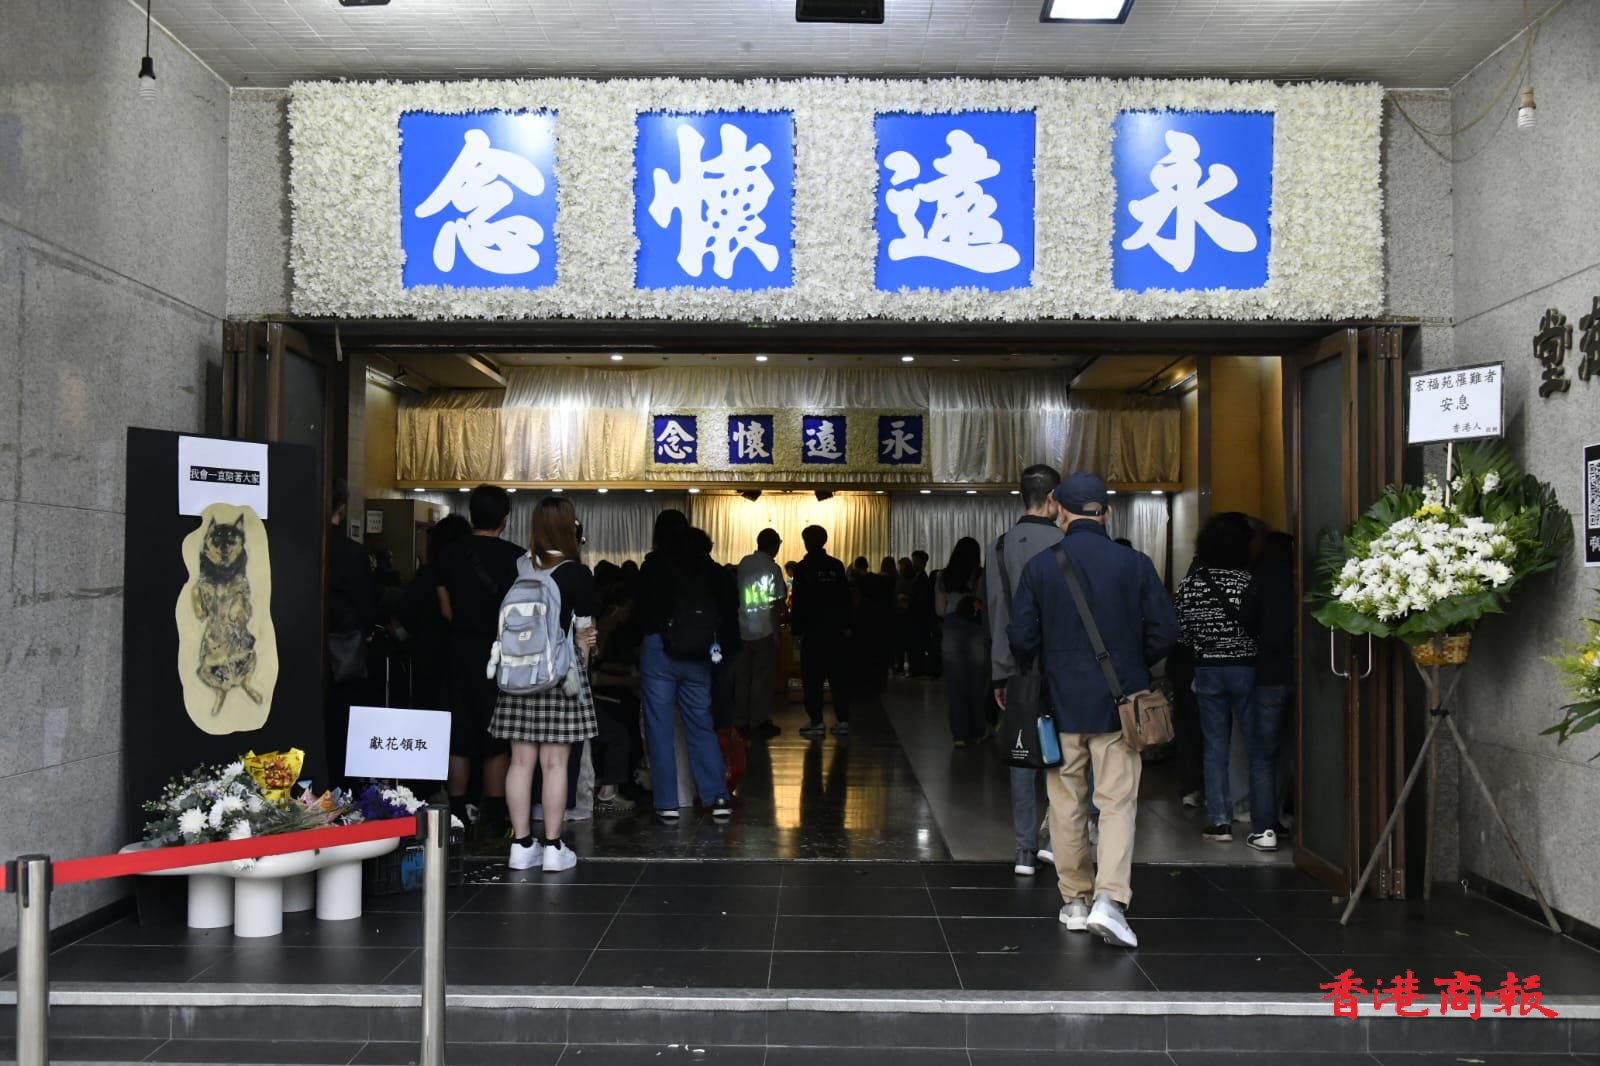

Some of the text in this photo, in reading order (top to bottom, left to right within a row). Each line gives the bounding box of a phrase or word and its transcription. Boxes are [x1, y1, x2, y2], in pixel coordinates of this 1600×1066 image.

[1440, 394, 1469, 412] 安息
[1452, 422, 1482, 433] 香港人
[190, 468, 260, 484] 我會一直陪著大家
[369, 735, 428, 751] 獻花領取
